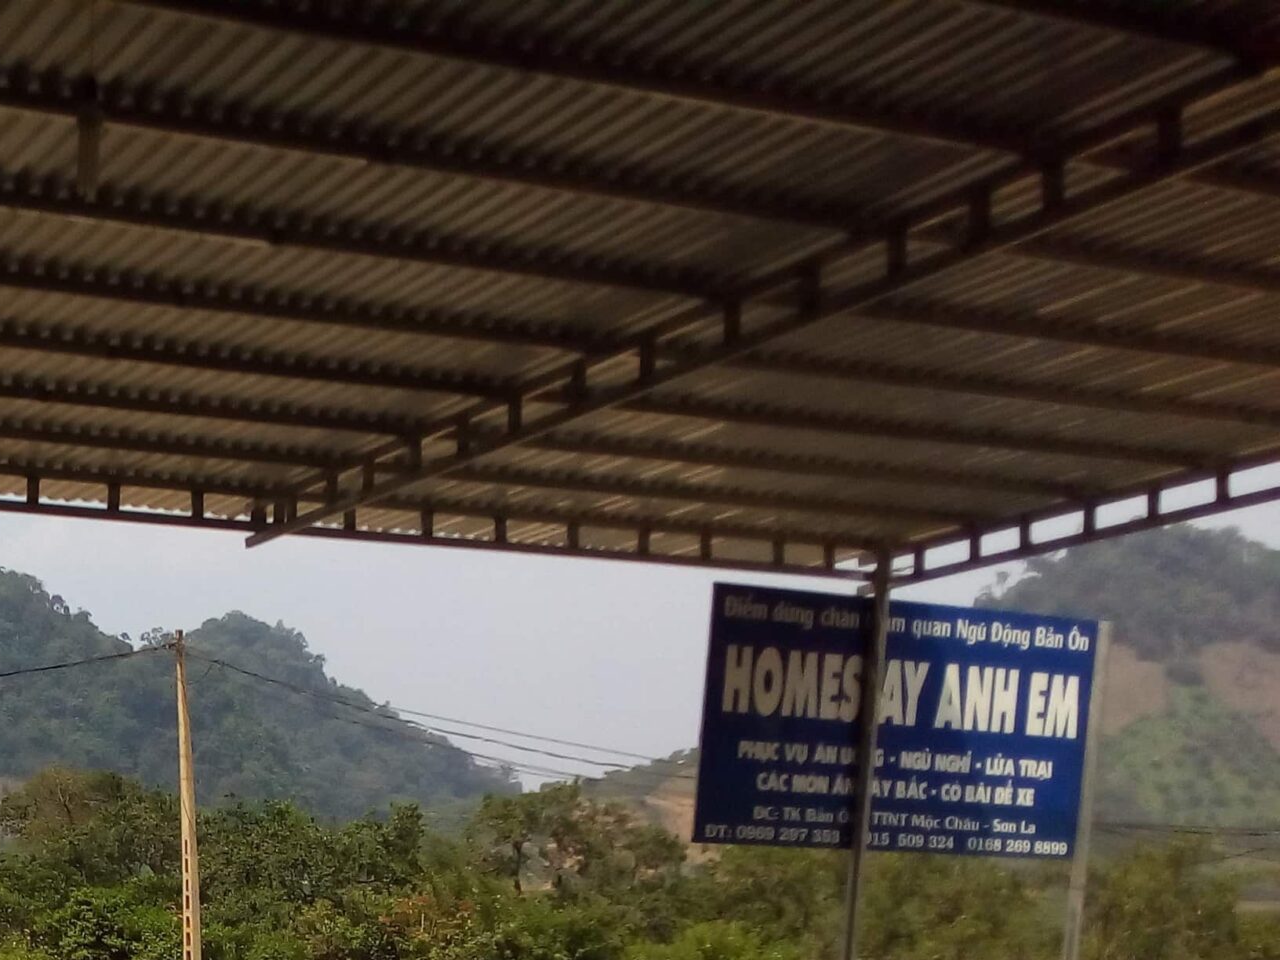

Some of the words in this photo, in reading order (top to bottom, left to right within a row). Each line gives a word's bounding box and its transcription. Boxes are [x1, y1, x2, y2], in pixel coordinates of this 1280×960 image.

[912, 619, 952, 639] quan
[990, 620, 1030, 650] Động
[1035, 625, 1064, 648] Bản
[1068, 625, 1090, 651] Ôn
[722, 644, 930, 727] HOMESAY
[934, 663, 1020, 734] ANH
[1025, 671, 1080, 739] EM
[737, 740, 780, 763] PHỤC
[784, 743, 809, 765] VỤ
[985, 752, 1015, 777] LỬA
[1019, 758, 1053, 781] TRẠI
[756, 770, 789, 792] CÁC
[941, 780, 962, 802] CÓ
[1016, 788, 1035, 807] XE
[911, 814, 941, 831] Mộc
[945, 815, 980, 831] Châu
[992, 818, 1017, 834] Sơn
[1020, 820, 1036, 835] La
